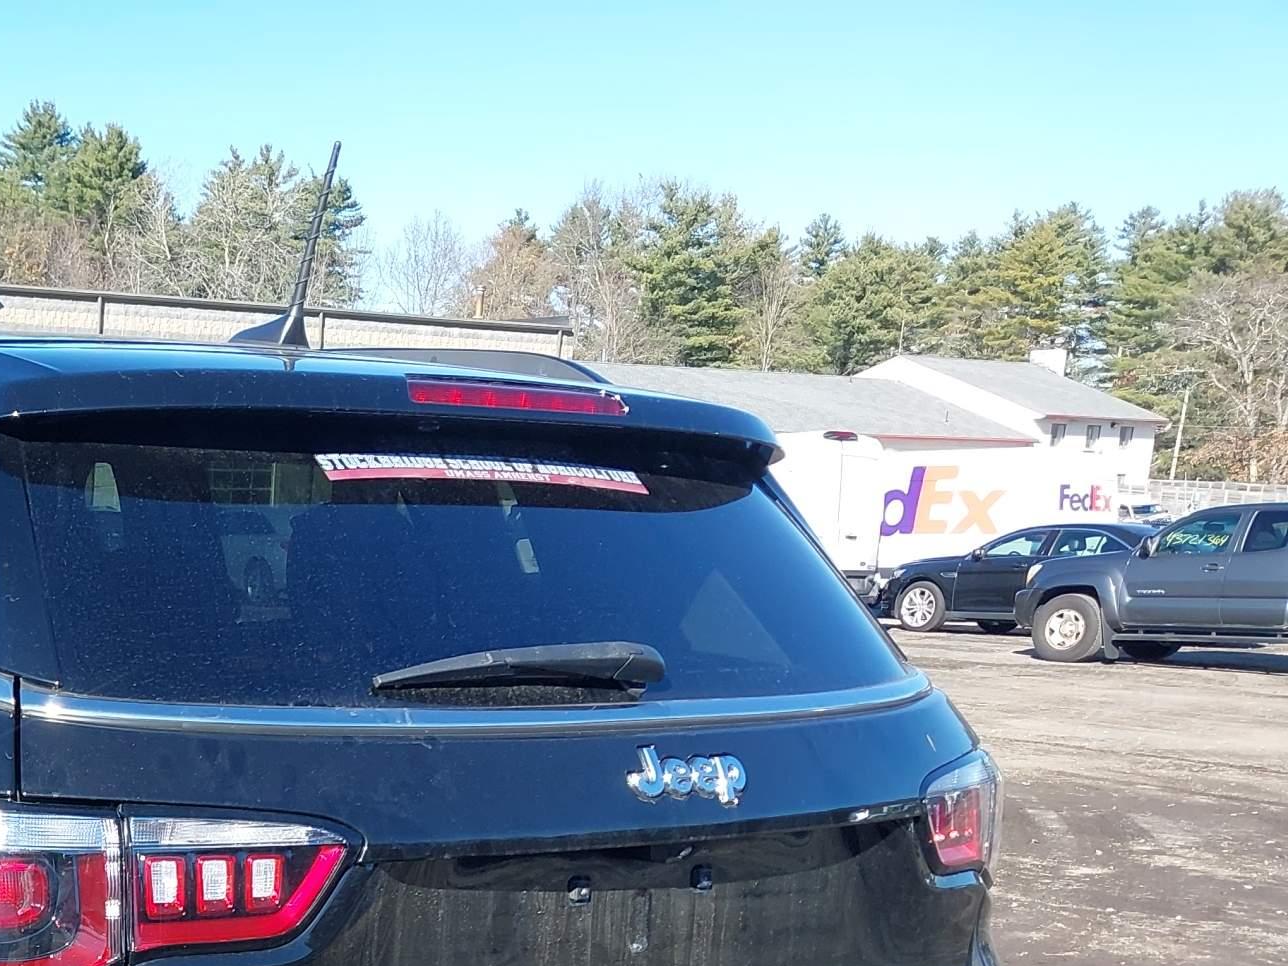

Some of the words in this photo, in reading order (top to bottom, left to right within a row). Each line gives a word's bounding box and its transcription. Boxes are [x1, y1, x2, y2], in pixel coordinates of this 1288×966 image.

[444, 459, 515, 472] SCHOOL
[513, 463, 533, 473] OF
[537, 464, 642, 485] AGRICULTURE
[444, 470, 491, 479] UMASS
[494, 471, 551, 482] AMHERST
[1058, 484, 1112, 512] FedEx
[626, 744, 747, 808] Jeep
